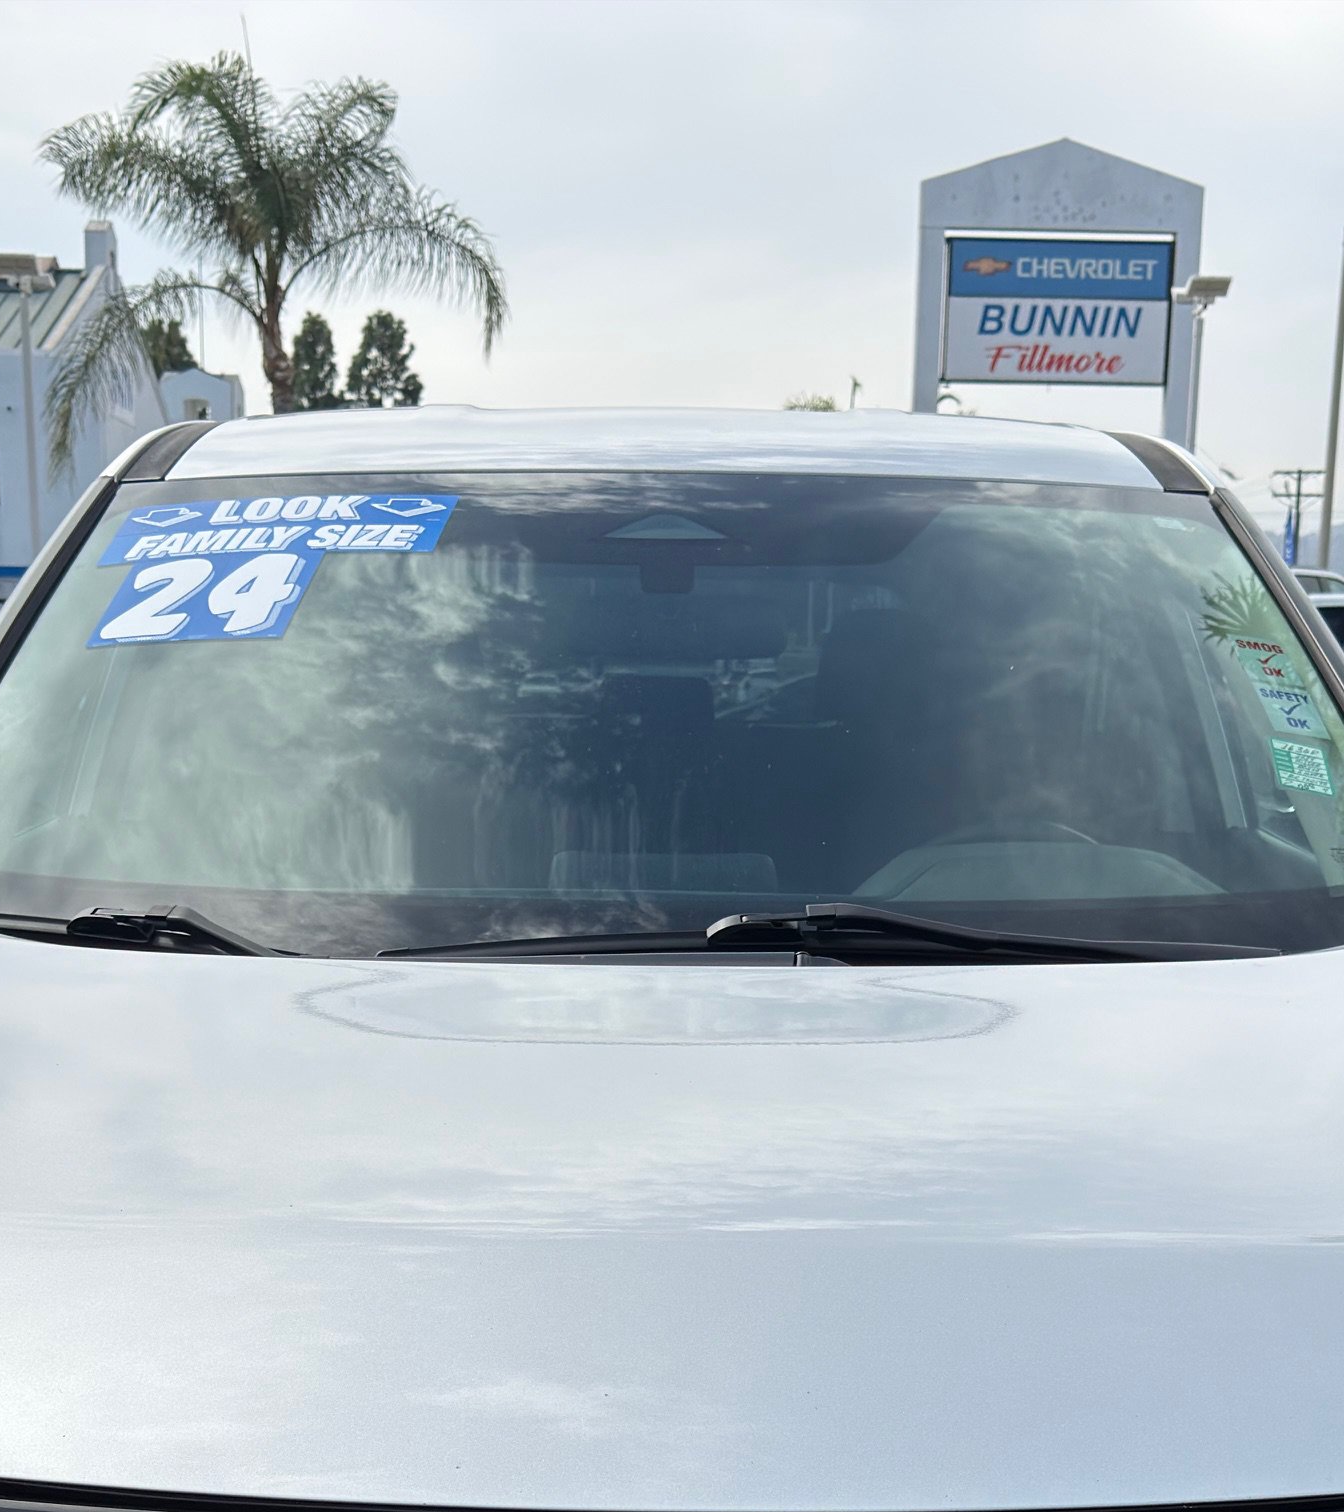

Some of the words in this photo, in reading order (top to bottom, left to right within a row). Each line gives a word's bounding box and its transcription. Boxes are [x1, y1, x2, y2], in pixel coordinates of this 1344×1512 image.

[1016, 257, 1157, 280] CHEVROLET
[977, 304, 1142, 338] BUNNIN
[985, 345, 1124, 374] Fillmore
[209, 495, 370, 525] LOOK
[124, 526, 311, 561] FAMILY
[306, 525, 425, 551] SIZE
[100, 553, 304, 642] 24
[1235, 639, 1283, 655] SMOG
[1262, 666, 1286, 679] OK
[1259, 688, 1309, 704] SAFETY
[1286, 716, 1312, 731] OK
